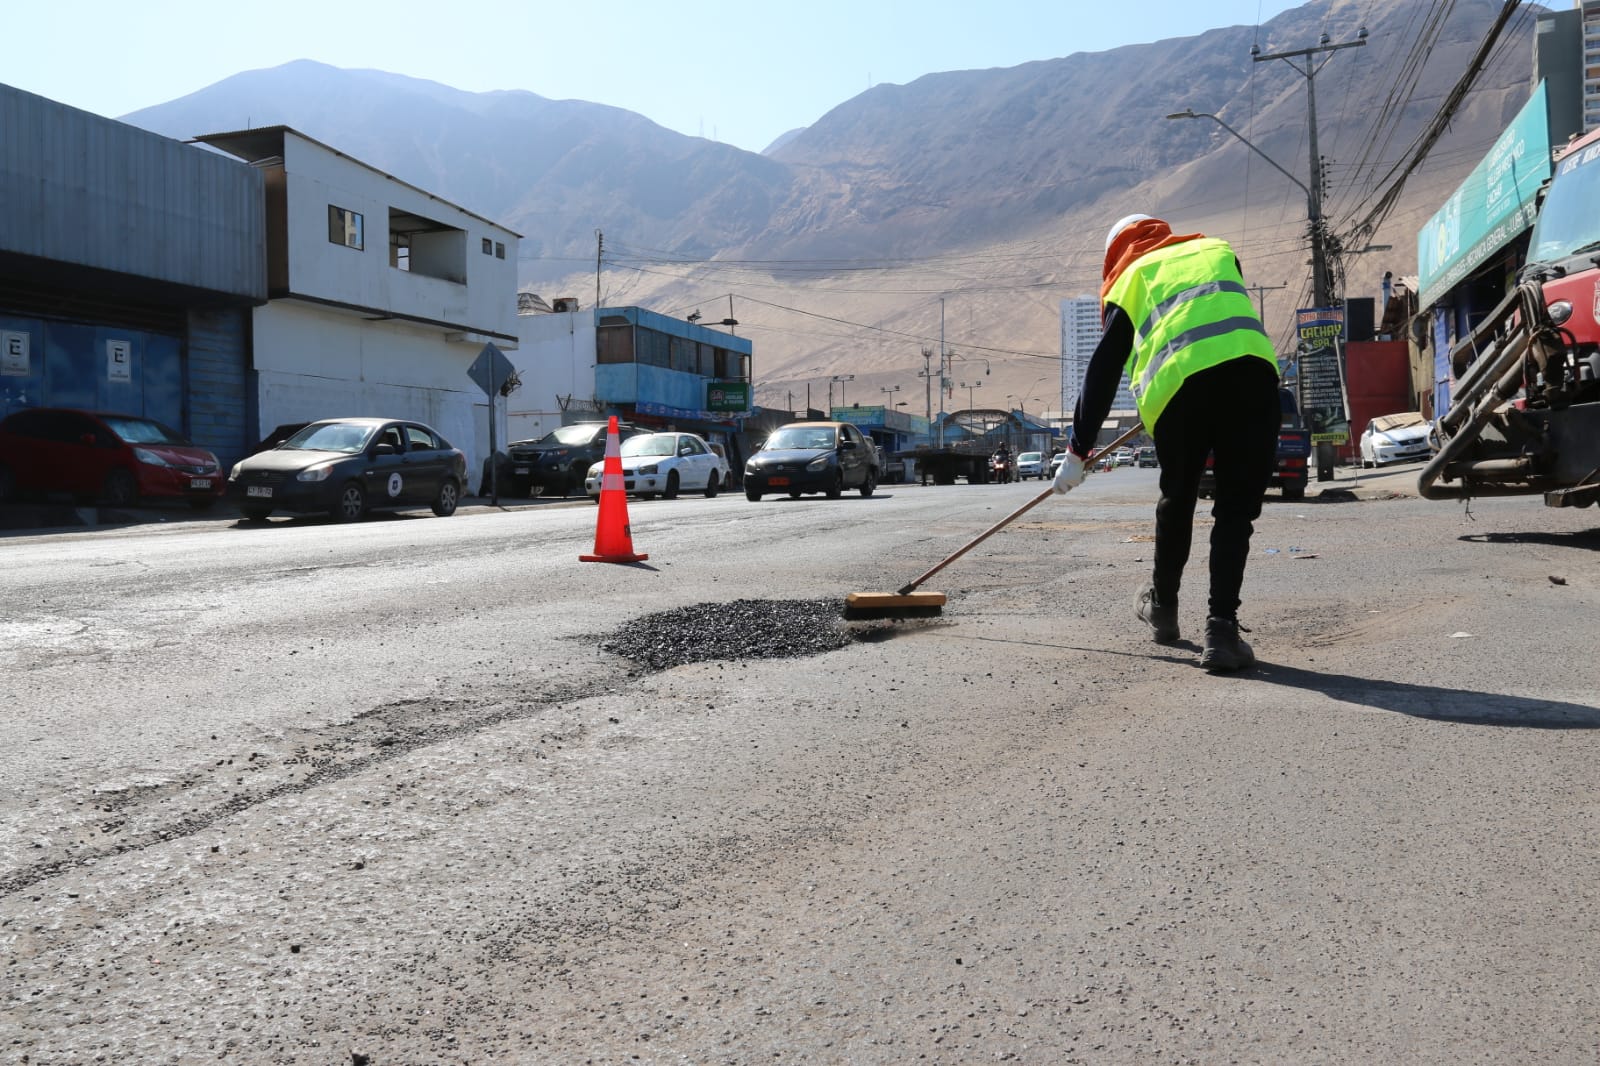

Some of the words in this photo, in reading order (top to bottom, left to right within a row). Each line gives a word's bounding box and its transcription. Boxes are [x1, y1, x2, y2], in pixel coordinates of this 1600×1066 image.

[1300, 324, 1342, 339] CACHAY
[10, 338, 21, 356] E
[1313, 338, 1330, 349] SPA
[114, 347, 124, 363] E
